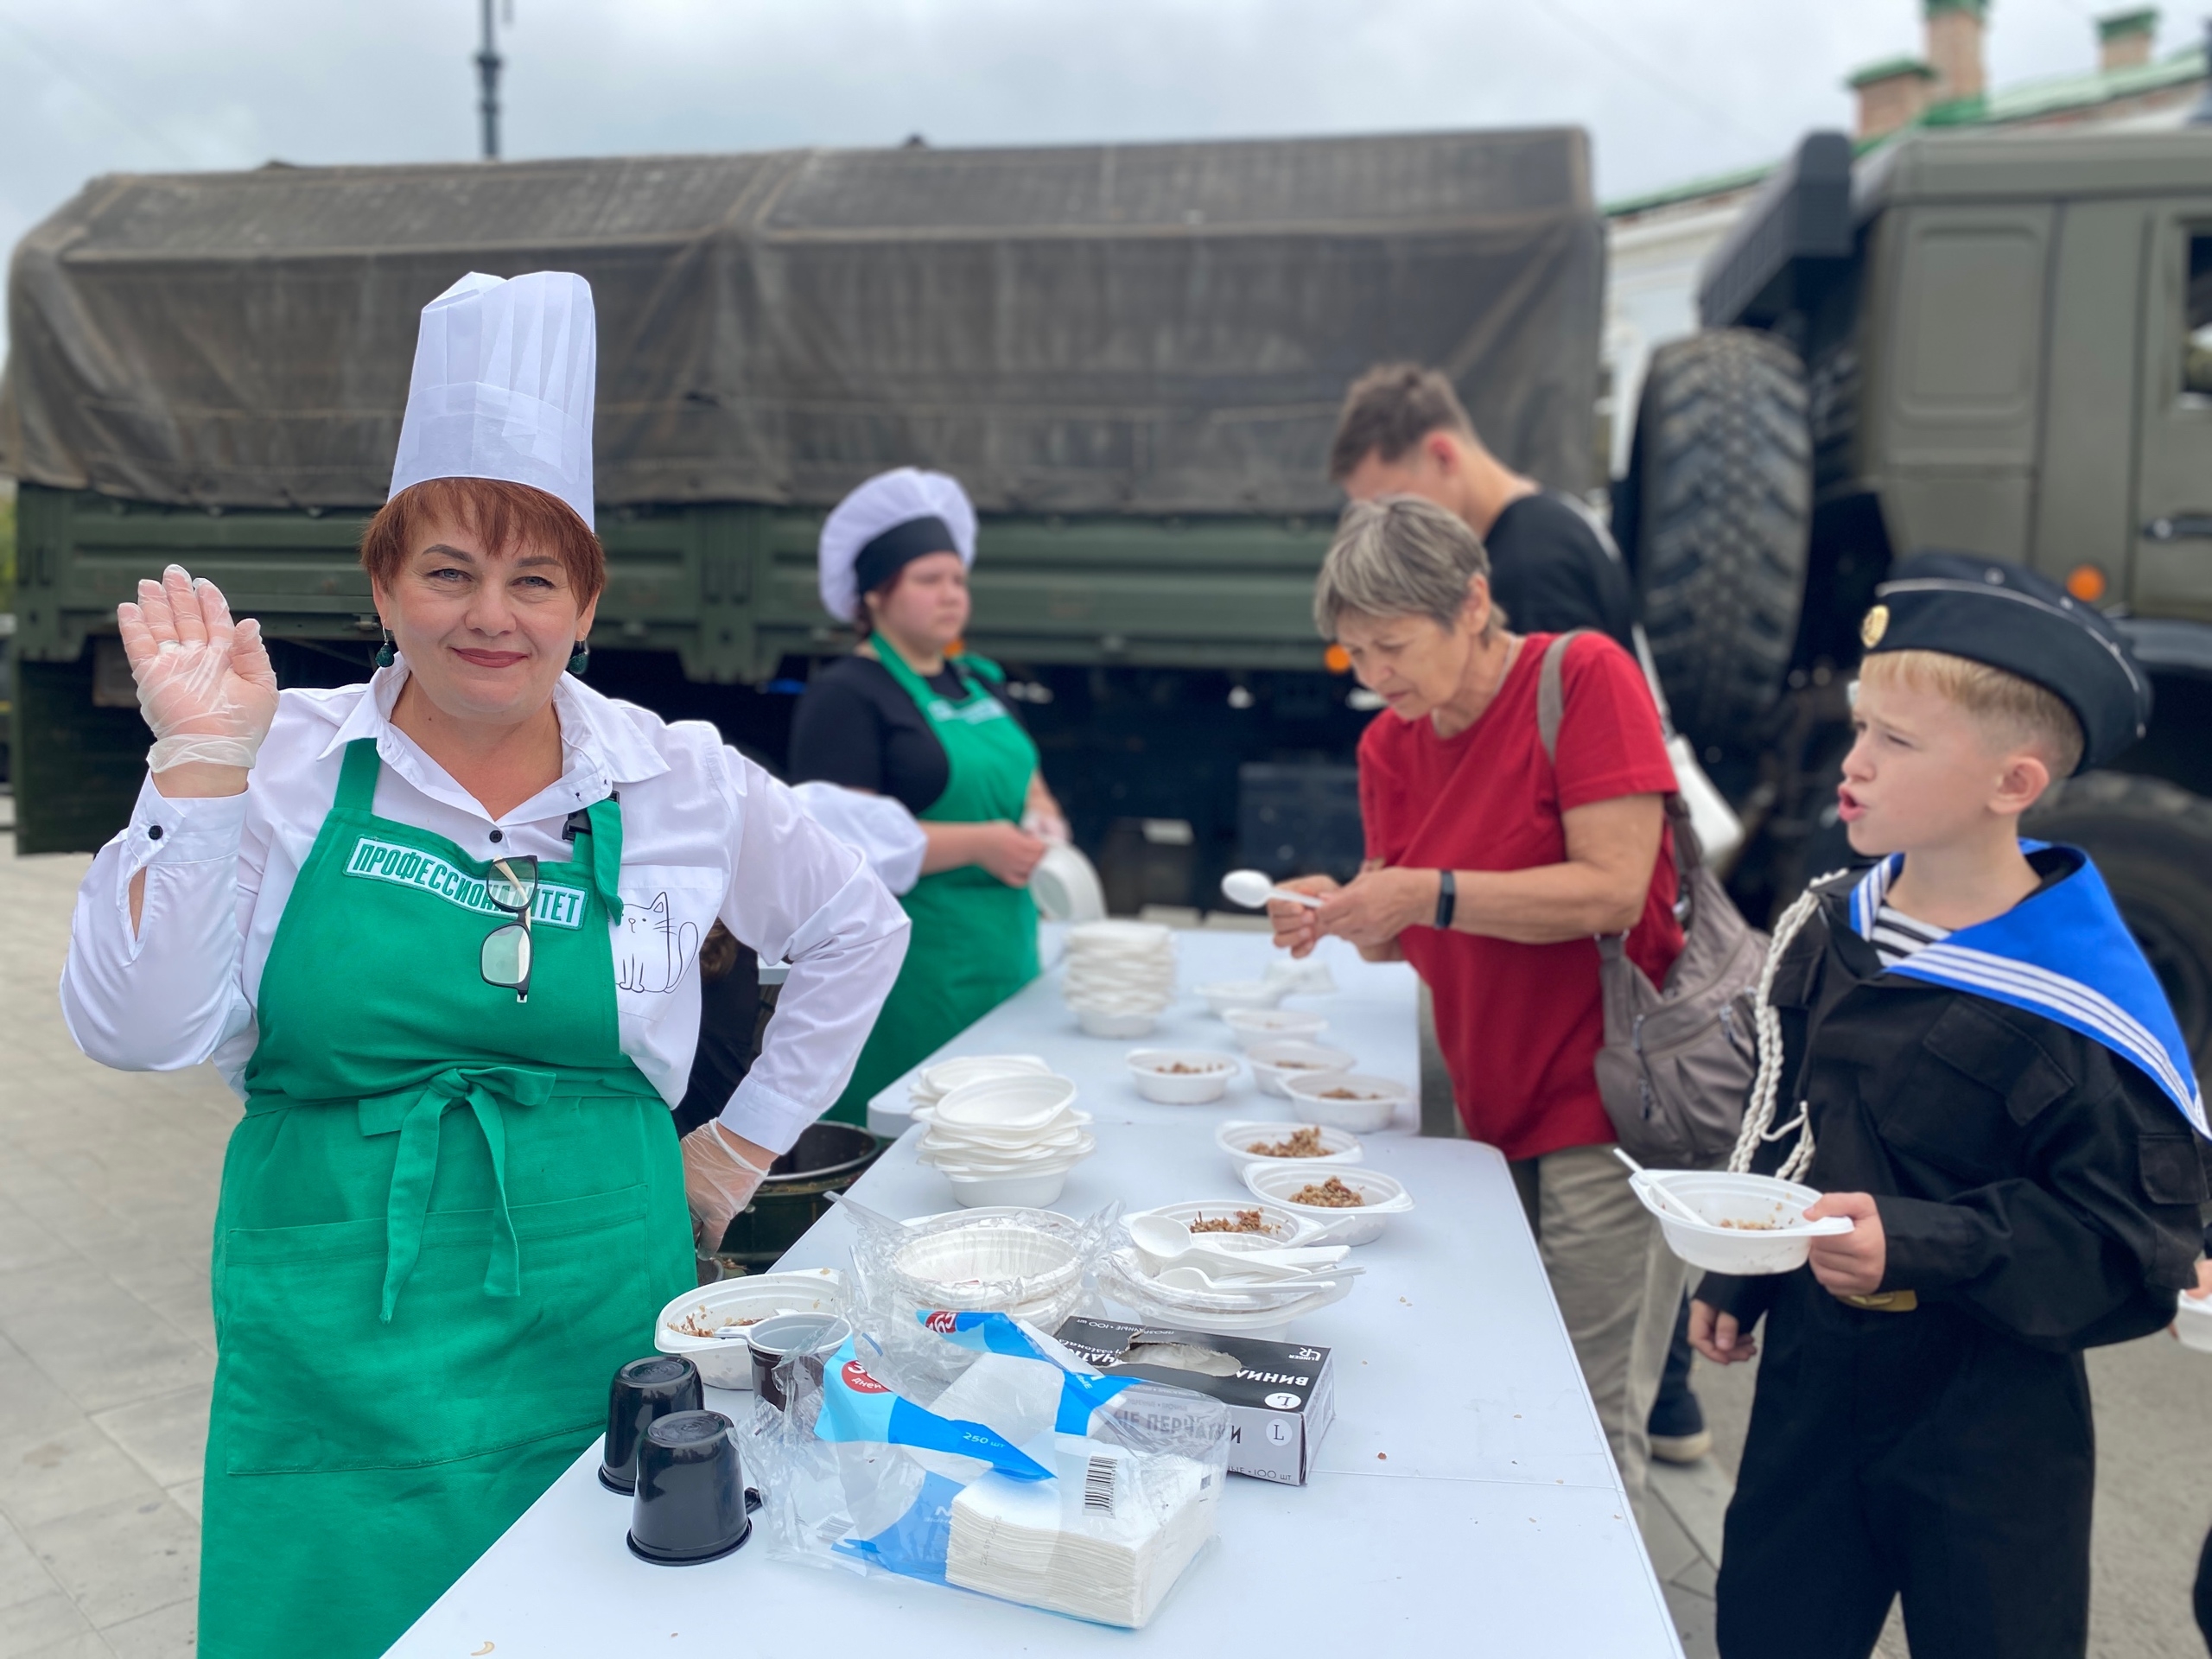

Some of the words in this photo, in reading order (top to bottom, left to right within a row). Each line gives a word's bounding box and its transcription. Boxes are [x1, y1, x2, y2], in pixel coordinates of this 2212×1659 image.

[1277, 1395, 1292, 1408] L
[963, 1432, 988, 1444] 250
[1273, 1424, 1285, 1440] L
[1254, 1469, 1277, 1478] 100
